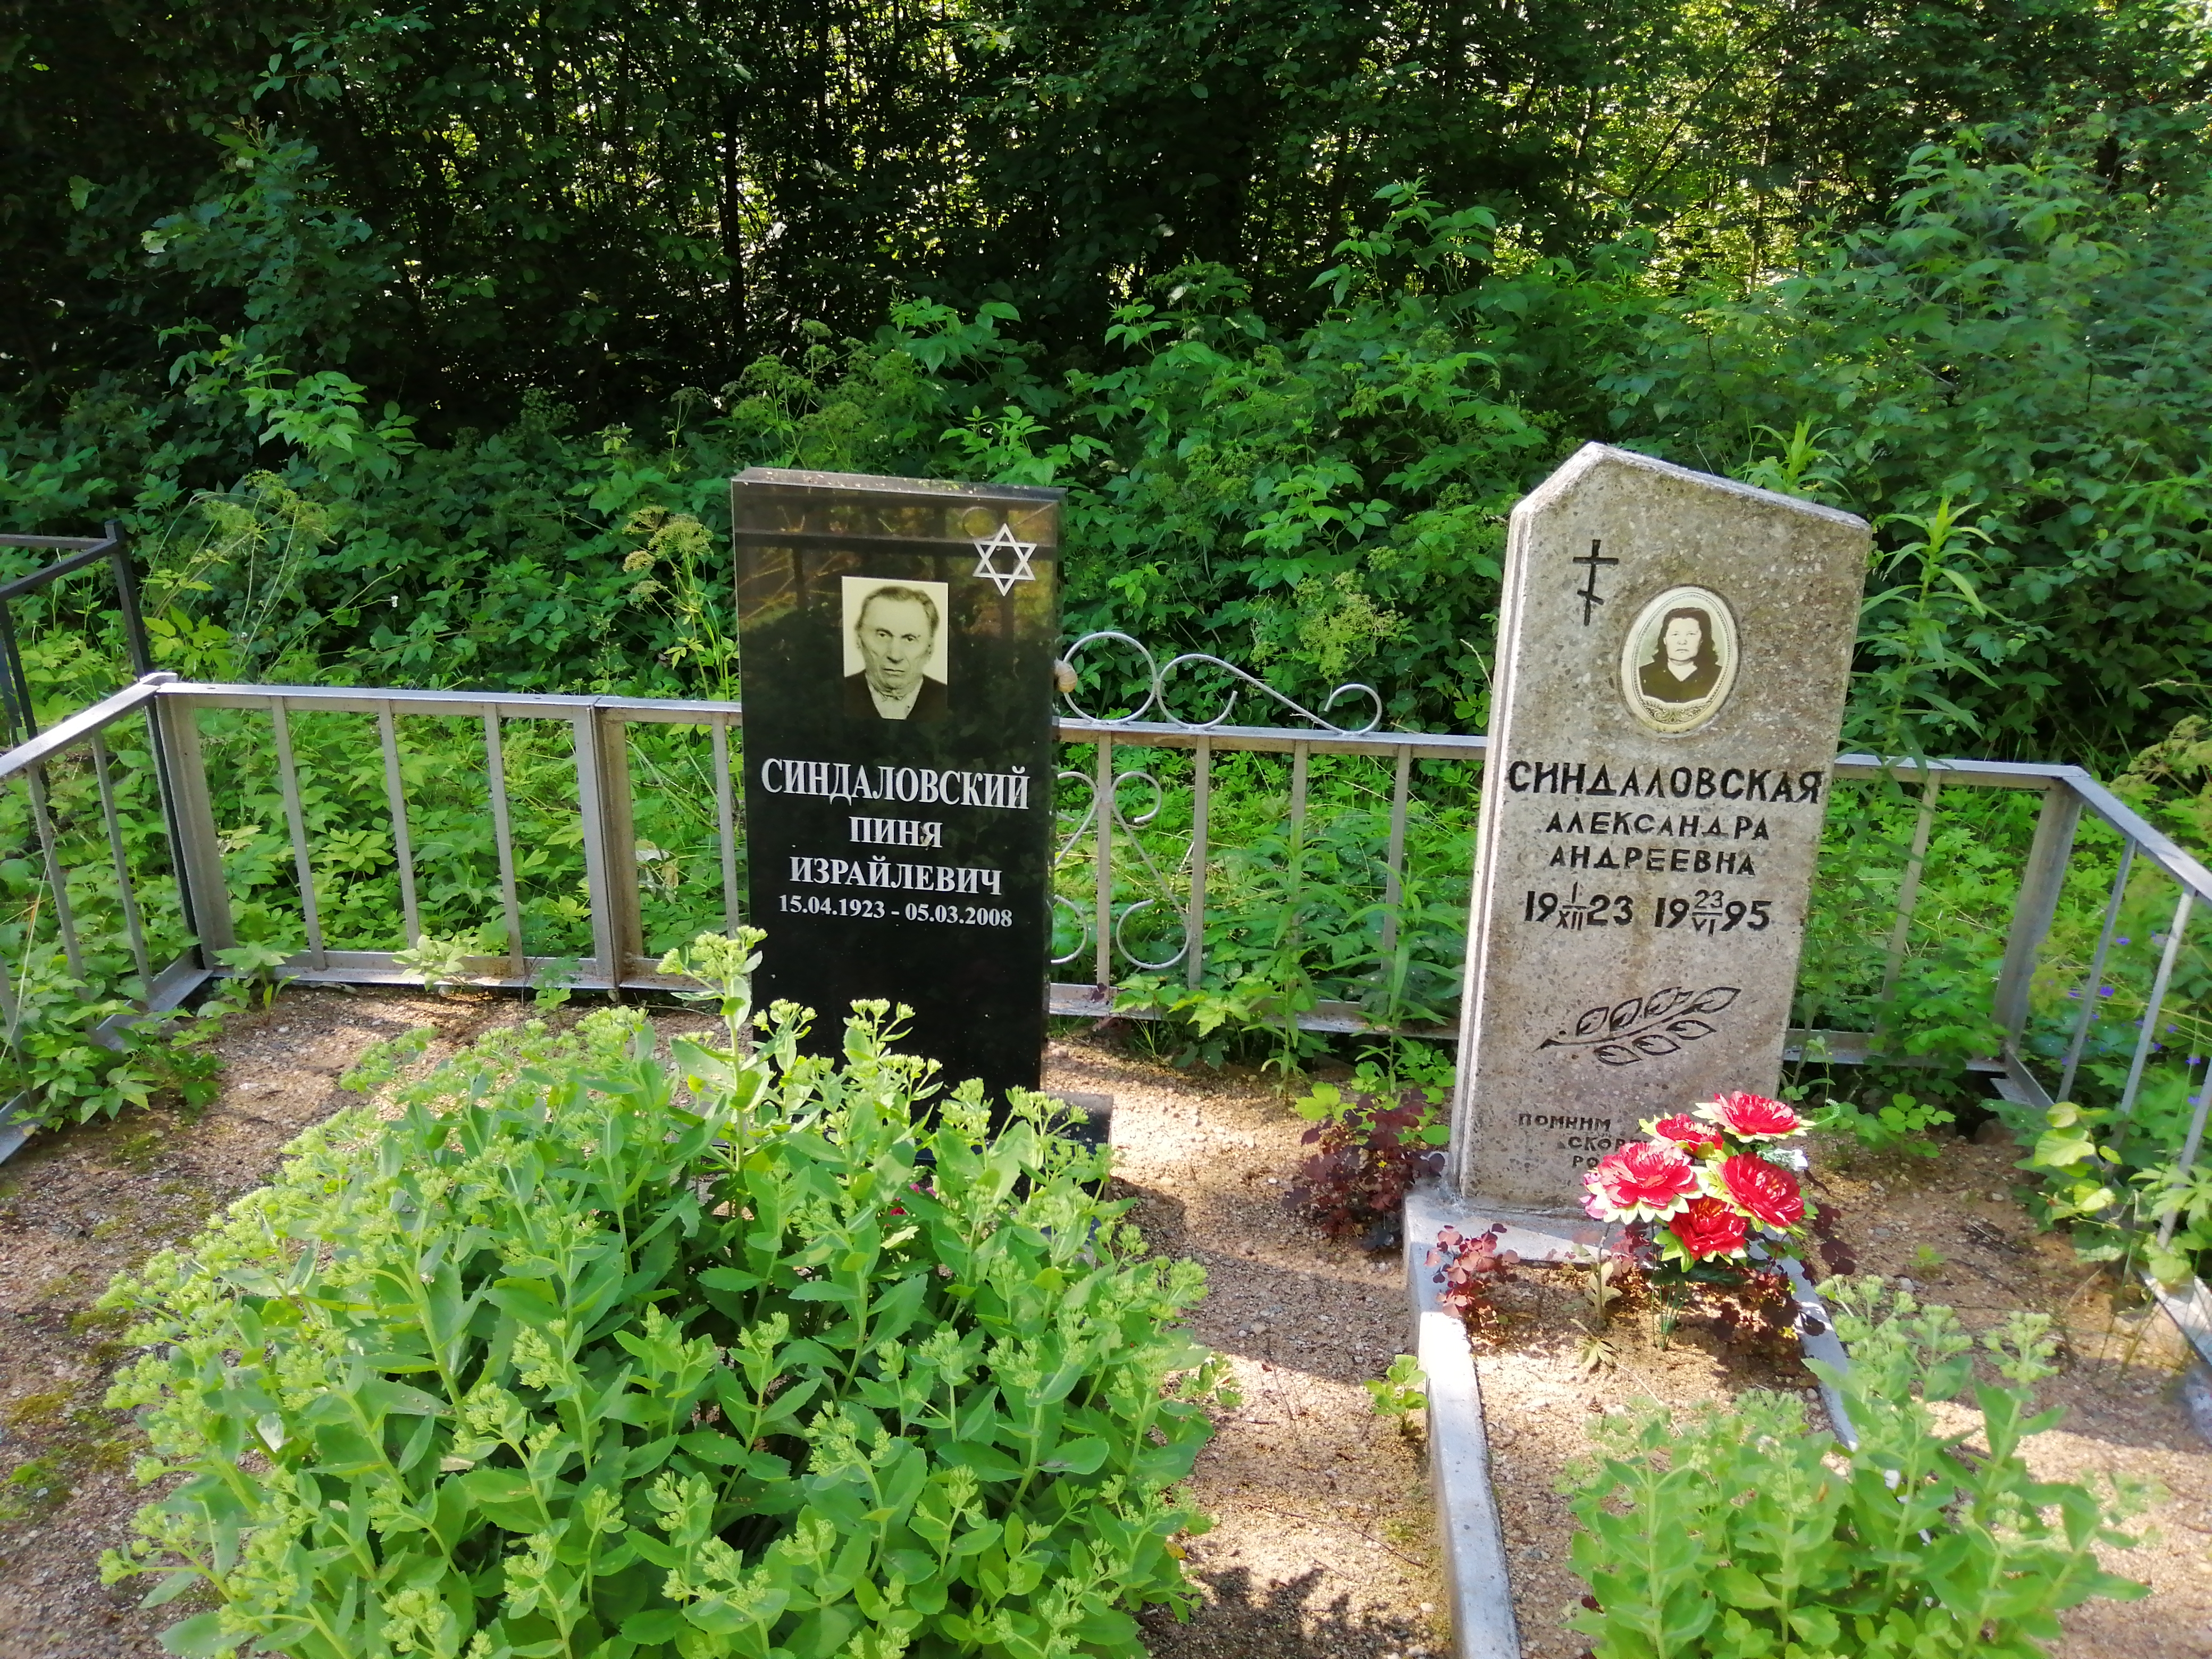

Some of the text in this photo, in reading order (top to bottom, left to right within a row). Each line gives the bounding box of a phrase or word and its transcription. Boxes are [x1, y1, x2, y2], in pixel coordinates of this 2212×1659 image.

[761, 758, 1030, 810] СИНДАЛОВСКИЙ
[1508, 760, 1826, 805] СИНДАЛОВСКАЯ
[849, 816, 943, 849] ПИНЯ
[1545, 810, 1770, 841] АЛЕКСАНДРА
[789, 854, 1003, 896] ИЗРАЙЛЕВИЧ
[1549, 845, 1756, 876] АНДРЕЕВНА
[778, 894, 886, 919] 15.04.1923
[904, 903, 1013, 928] 05.03.2008
